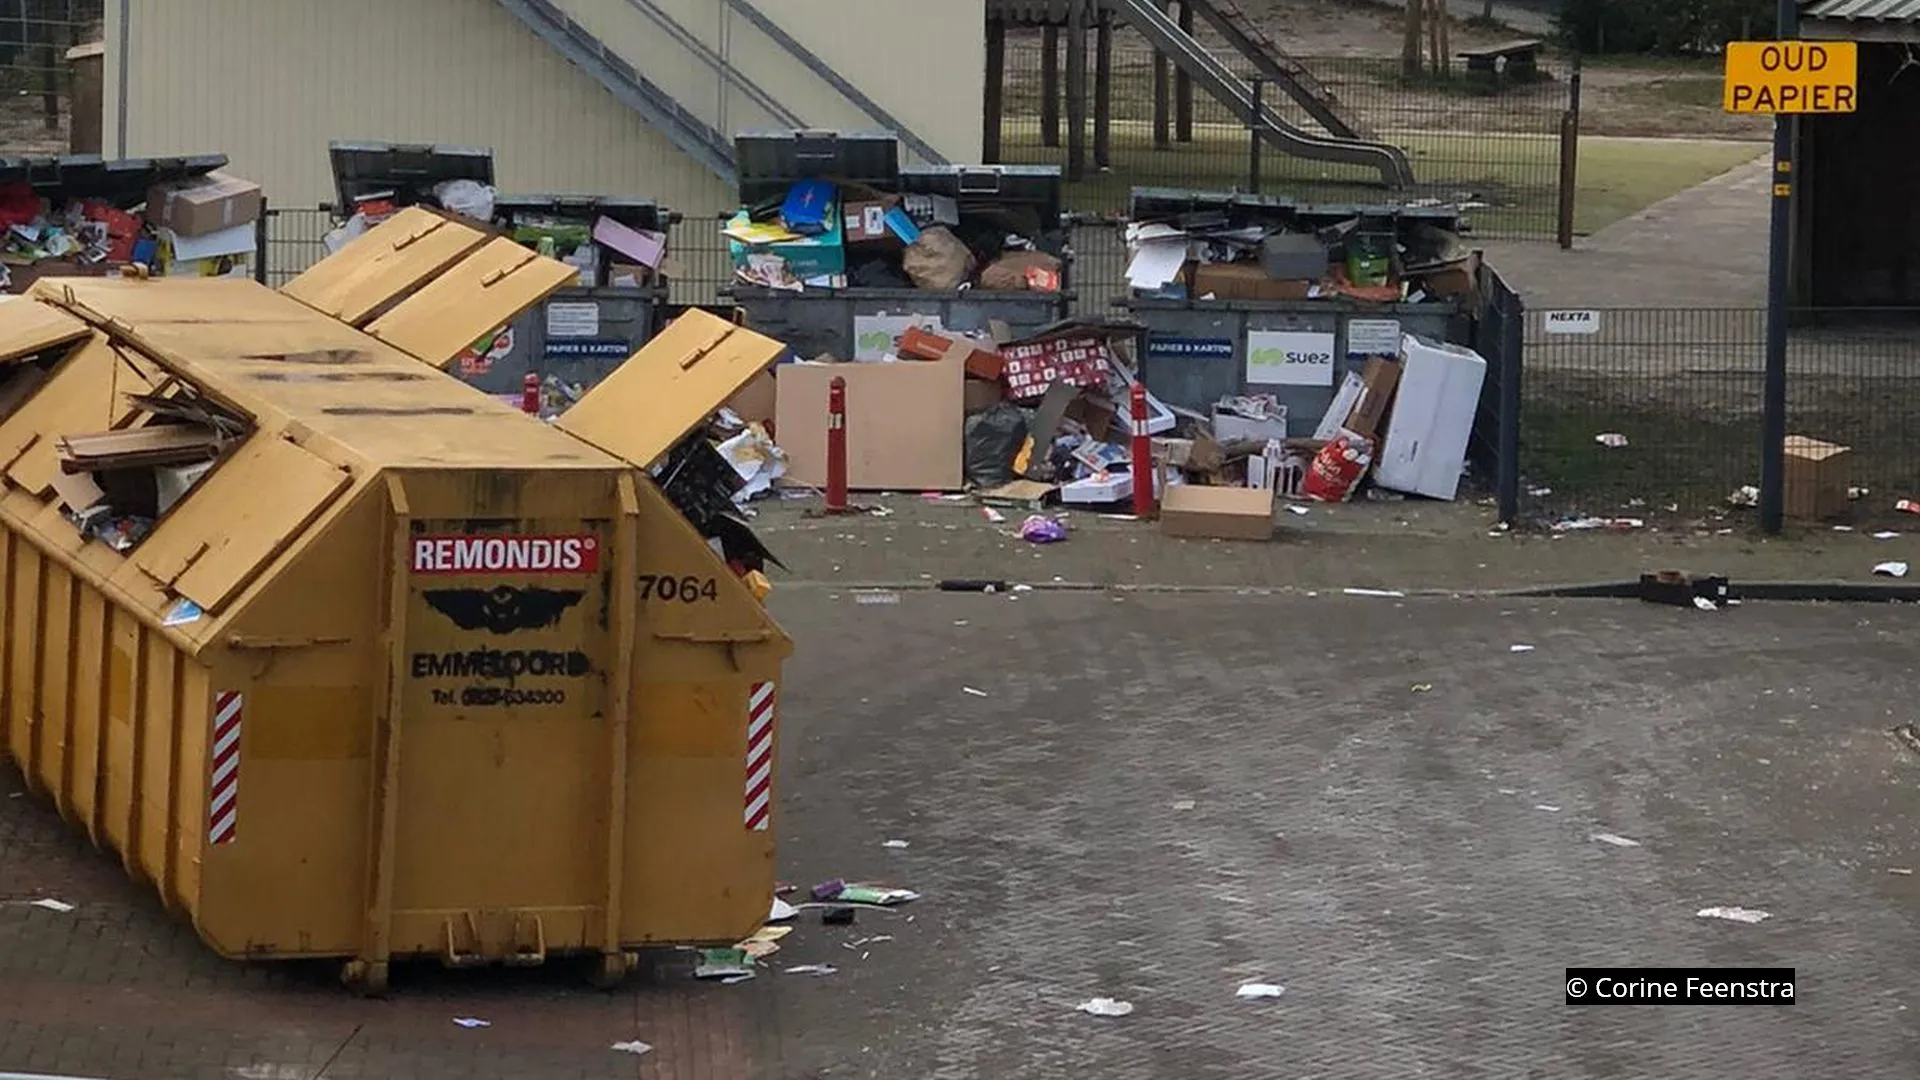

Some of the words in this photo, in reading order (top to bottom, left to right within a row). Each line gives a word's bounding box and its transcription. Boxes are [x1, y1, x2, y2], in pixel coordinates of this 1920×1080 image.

[1761, 46, 1827, 71] OUD
[1732, 85, 1854, 110] PAPIER
[546, 344, 579, 353] PAPIER
[589, 344, 628, 353] KARTON
[1149, 342, 1183, 352] PAPIER
[1193, 343, 1232, 353] KARTON
[638, 575, 718, 603] 7064
[411, 650, 589, 678] EMMEOORD
[432, 689, 456, 705] Tel.
